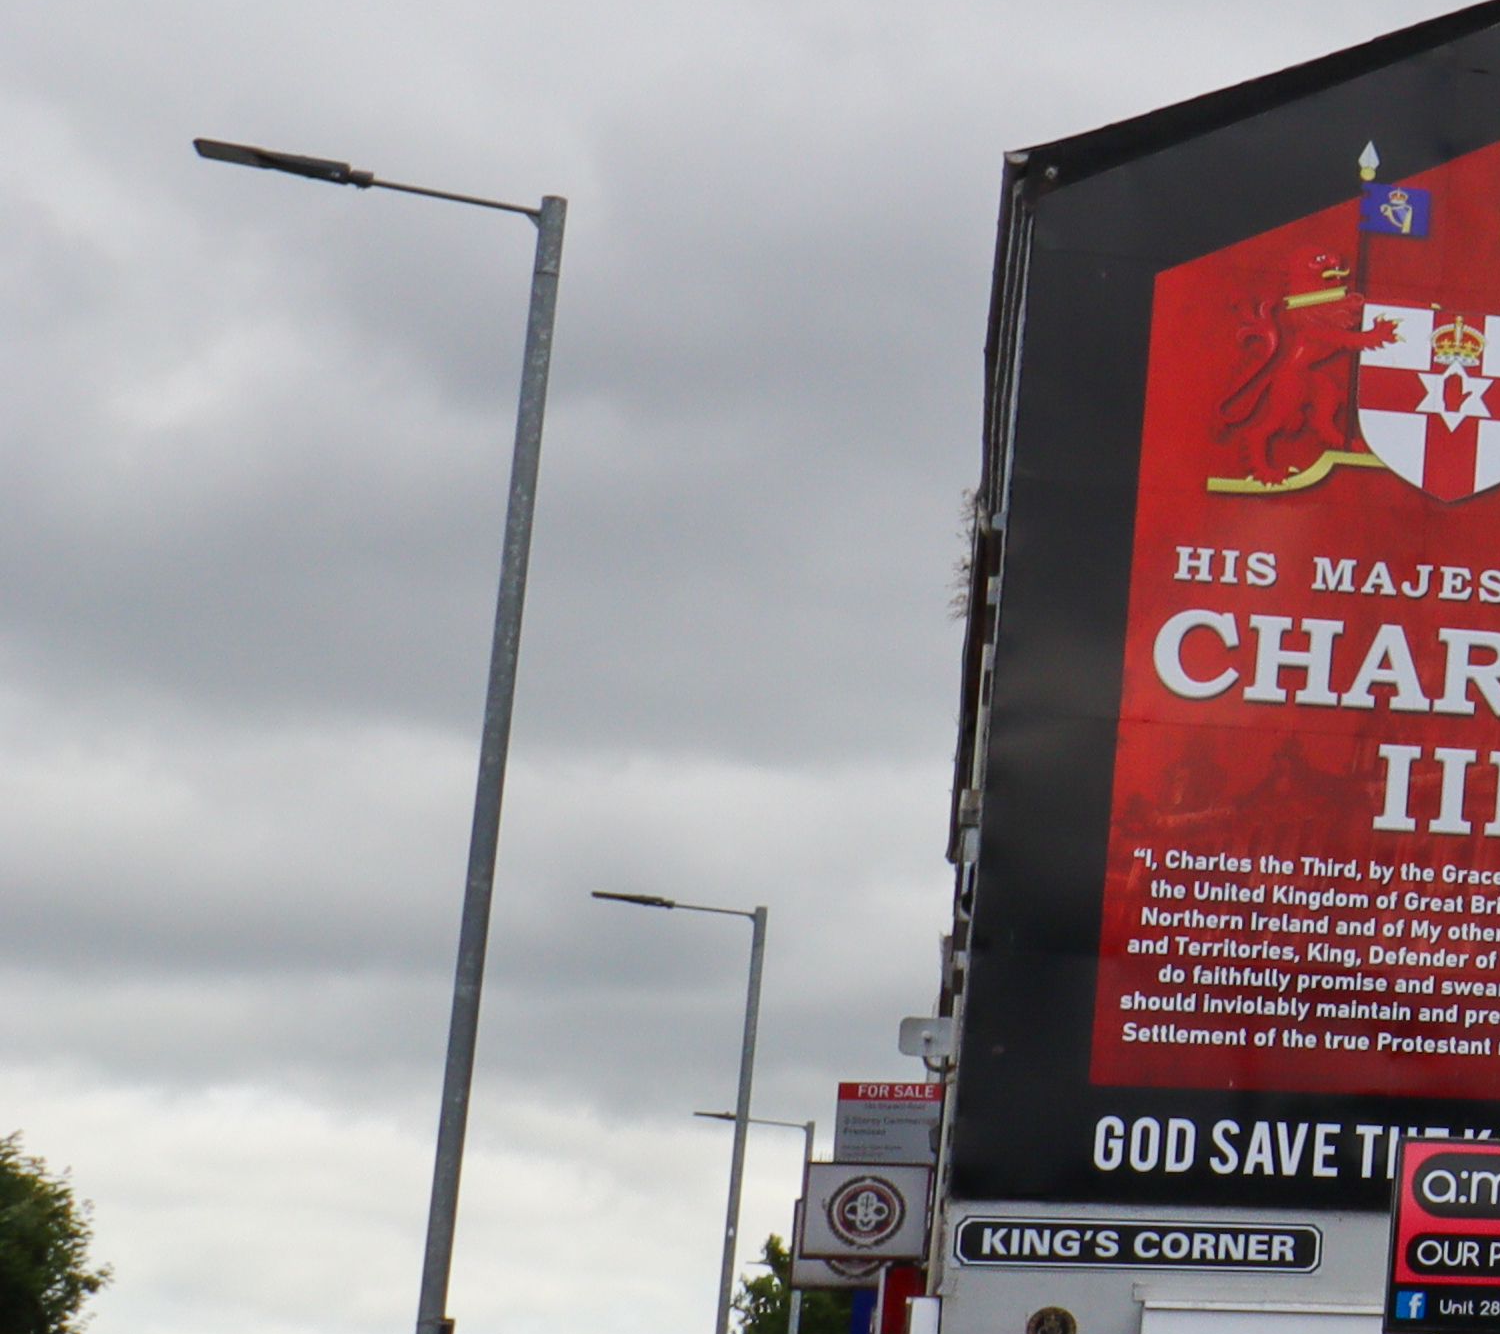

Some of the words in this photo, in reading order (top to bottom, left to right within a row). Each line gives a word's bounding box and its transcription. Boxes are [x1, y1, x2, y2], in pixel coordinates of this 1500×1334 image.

[1173, 546, 1278, 586] HIS
[1165, 849, 1252, 873] Charles
[1259, 855, 1294, 875] the
[1301, 856, 1362, 880] Third,
[1369, 861, 1394, 884] by
[1401, 863, 1435, 882] the
[1151, 880, 1186, 899] the
[1194, 881, 1265, 903] United
[1272, 885, 1369, 910] Kingdom
[1376, 891, 1397, 910] of
[1404, 891, 1463, 913] Great
[1141, 907, 1243, 930] Northern
[1250, 911, 1329, 934] Ireland
[1336, 918, 1376, 936] and
[1382, 919, 1405, 937] of
[1411, 920, 1442, 943] My
[1127, 936, 1169, 955] and
[1175, 936, 1300, 963] Territories,
[1307, 943, 1362, 967] King,
[1369, 945, 1469, 967] Defender
[1475, 951, 1497, 969] of
[1158, 964, 1186, 983] do
[1192, 965, 1291, 992] faithfully
[1297, 973, 1388, 993] promise
[1394, 976, 1435, 994] and
[1120, 991, 1197, 1012] should
[1203, 993, 1309, 1021] inviolably
[1316, 1000, 1412, 1021] maintain
[1418, 1004, 1459, 1023] and
[1122, 1022, 1247, 1046] Settlement
[1254, 1027, 1277, 1047] of
[1282, 1028, 1318, 1047] the
[1324, 1032, 1370, 1051] true
[1377, 1032, 1491, 1055] Protestant
[857, 1083, 889, 1098] FOR
[894, 1084, 935, 1099] SALE
[1093, 1115, 1197, 1174] GOD
[1210, 1119, 1340, 1179] SAVE
[981, 1227, 1120, 1258] KING'S
[1132, 1230, 1296, 1261] CORNER
[1416, 1239, 1480, 1267] OUR
[1439, 1299, 1474, 1316] Unit
[1480, 1300, 1500, 1317] 28
